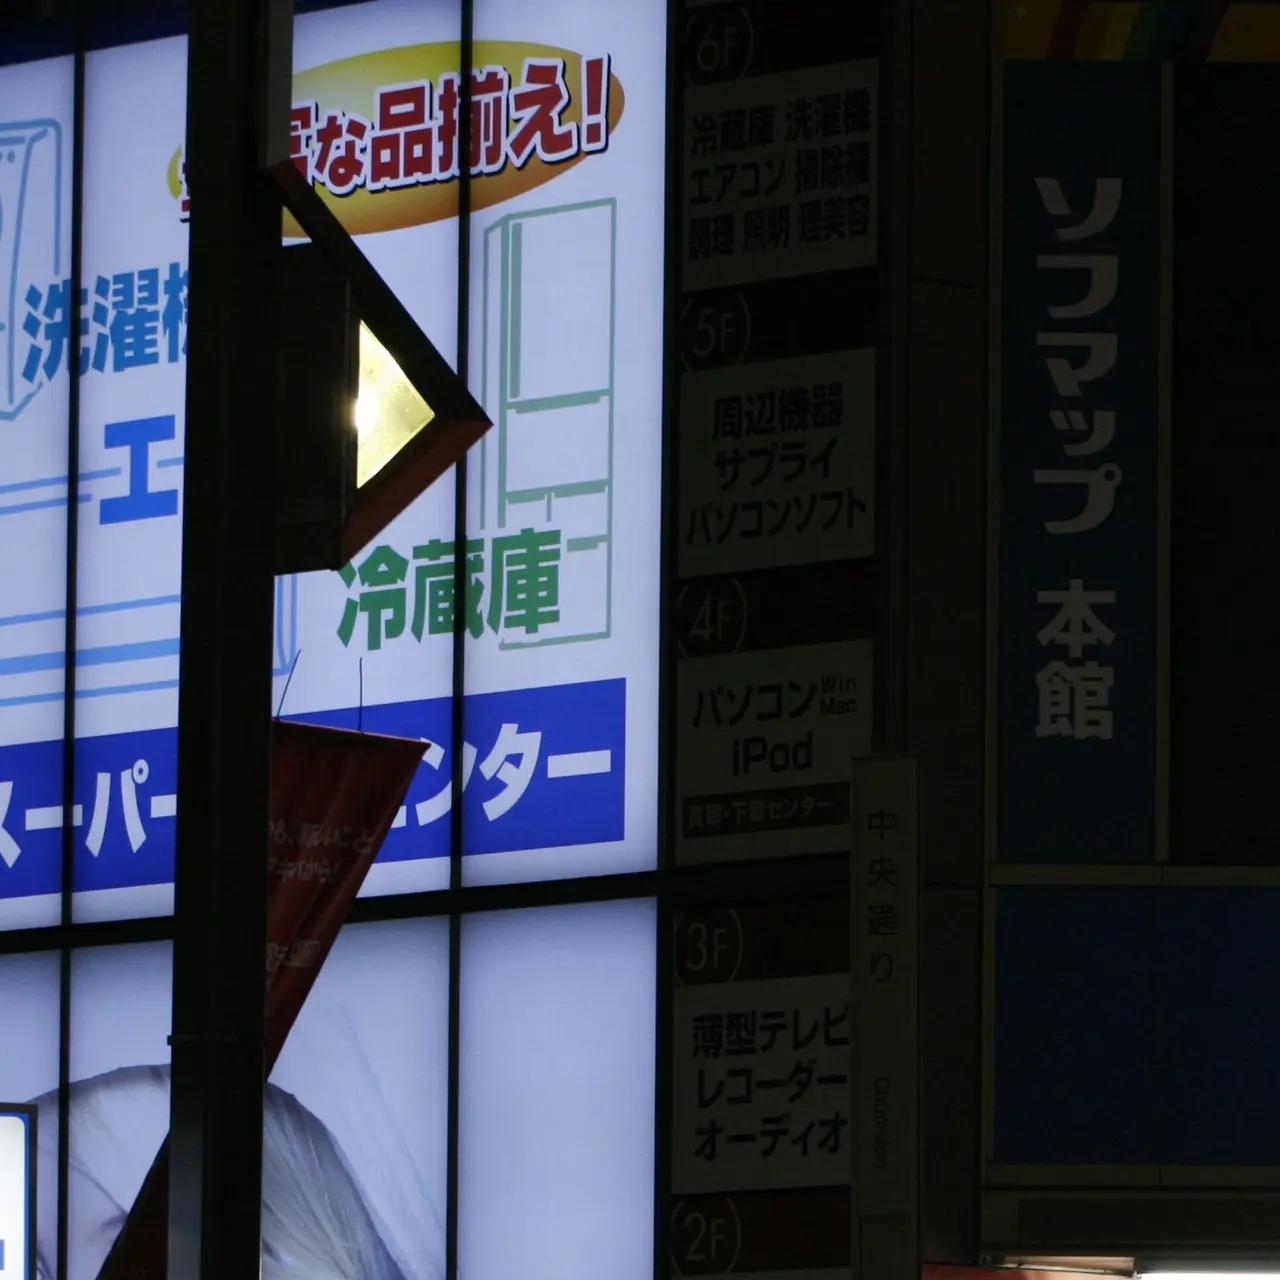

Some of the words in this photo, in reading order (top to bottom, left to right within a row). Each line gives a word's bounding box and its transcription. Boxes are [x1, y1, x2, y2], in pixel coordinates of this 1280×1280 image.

[695, 24, 741, 66] 6F
[690, 159, 784, 206] エアコン
[694, 312, 737, 357] 5F
[1033, 177, 1123, 535] ソフマップ
[714, 438, 837, 492] サプライ
[686, 488, 867, 545] パソコンソフト
[336, 527, 561, 651] 冷蔵庫
[689, 596, 736, 643] 4F
[1035, 578, 1117, 740] 本館
[692, 681, 816, 729] パソコン
[732, 732, 814, 777] iPod
[866, 808, 898, 984] 中央通り
[686, 922, 728, 972] 3F
[698, 1062, 848, 1110] レコーダー
[695, 1111, 848, 1161] オーディオ
[685, 1212, 725, 1262] 2F
